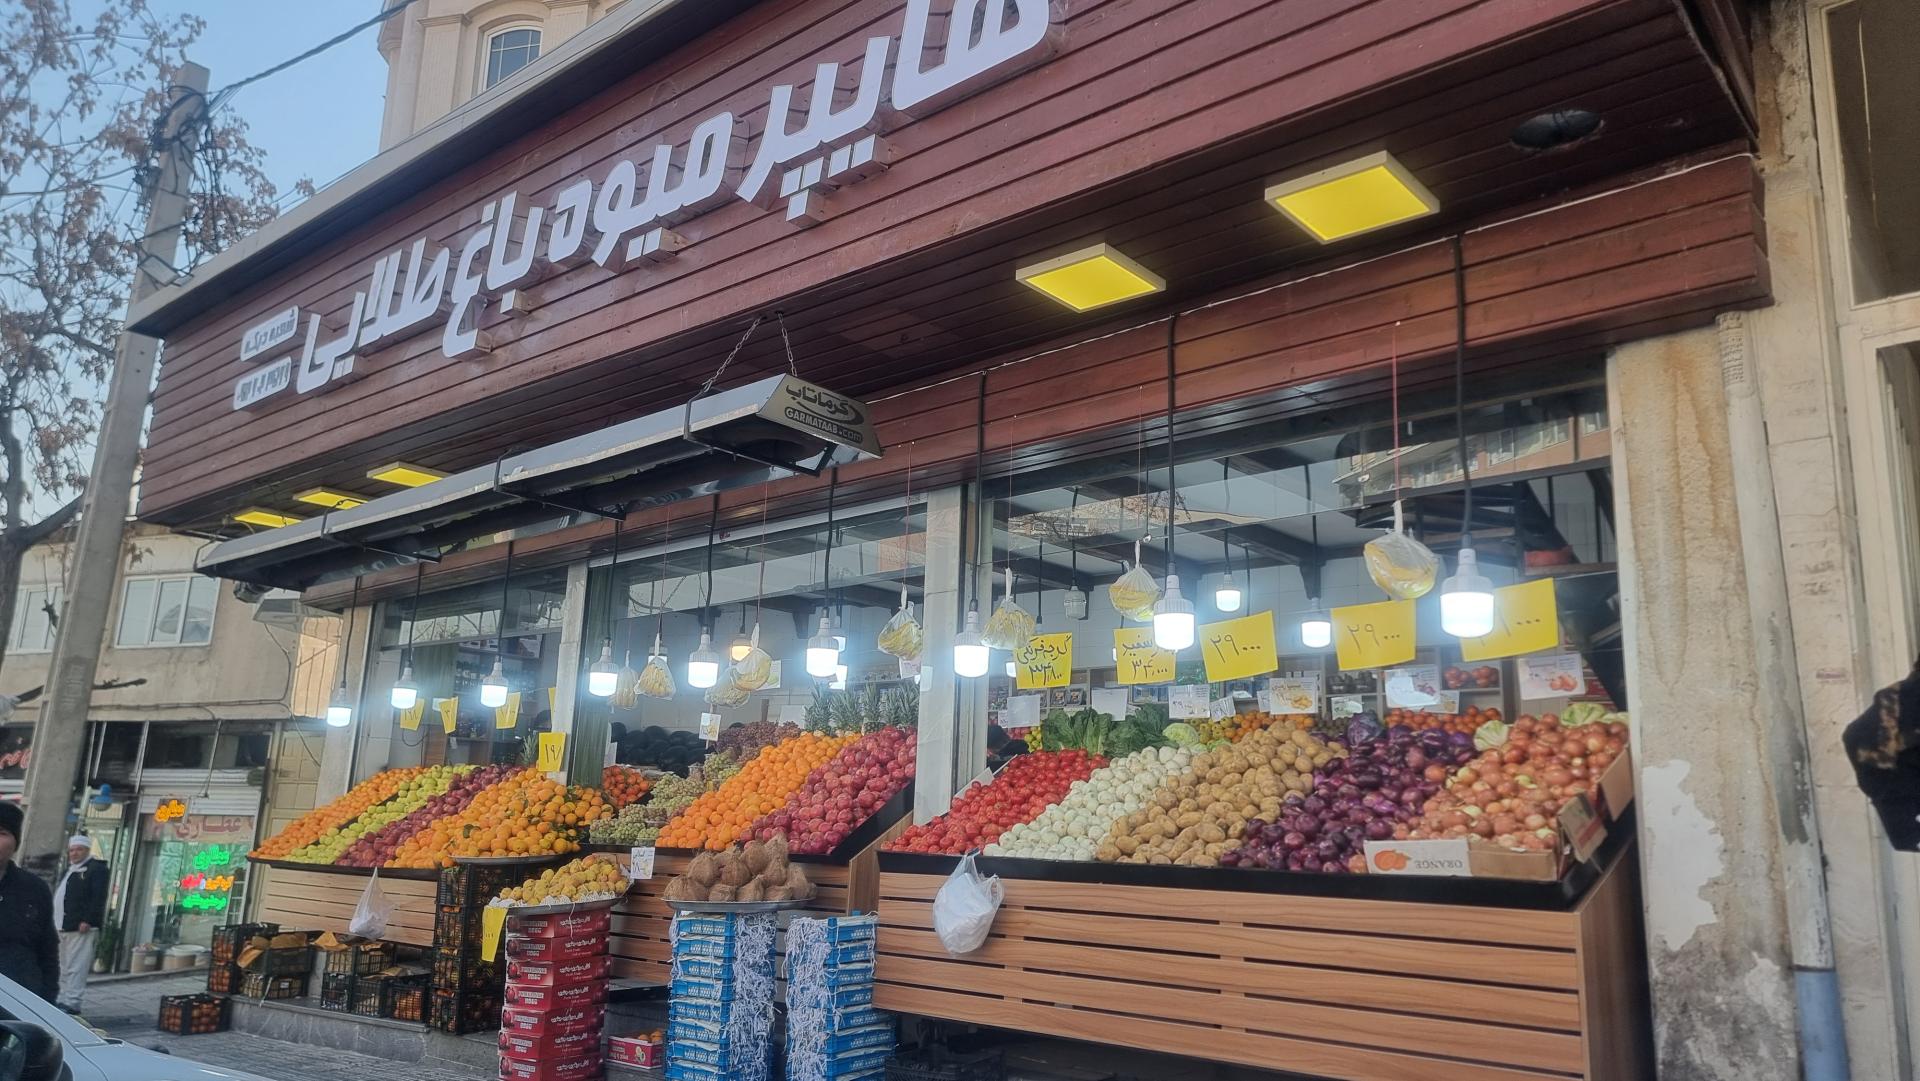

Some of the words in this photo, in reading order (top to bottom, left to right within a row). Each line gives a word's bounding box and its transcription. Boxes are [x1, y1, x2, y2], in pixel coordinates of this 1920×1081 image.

[736, 0, 1049, 221] هایپر
[548, 111, 733, 267] میوه
[297, 236, 449, 395] طلایی
[442, 190, 543, 358] باغ
[785, 384, 849, 416] گرماتاب
[785, 407, 862, 441] GARMATAAB.com
[1415, 860, 1464, 869] ORANGE
